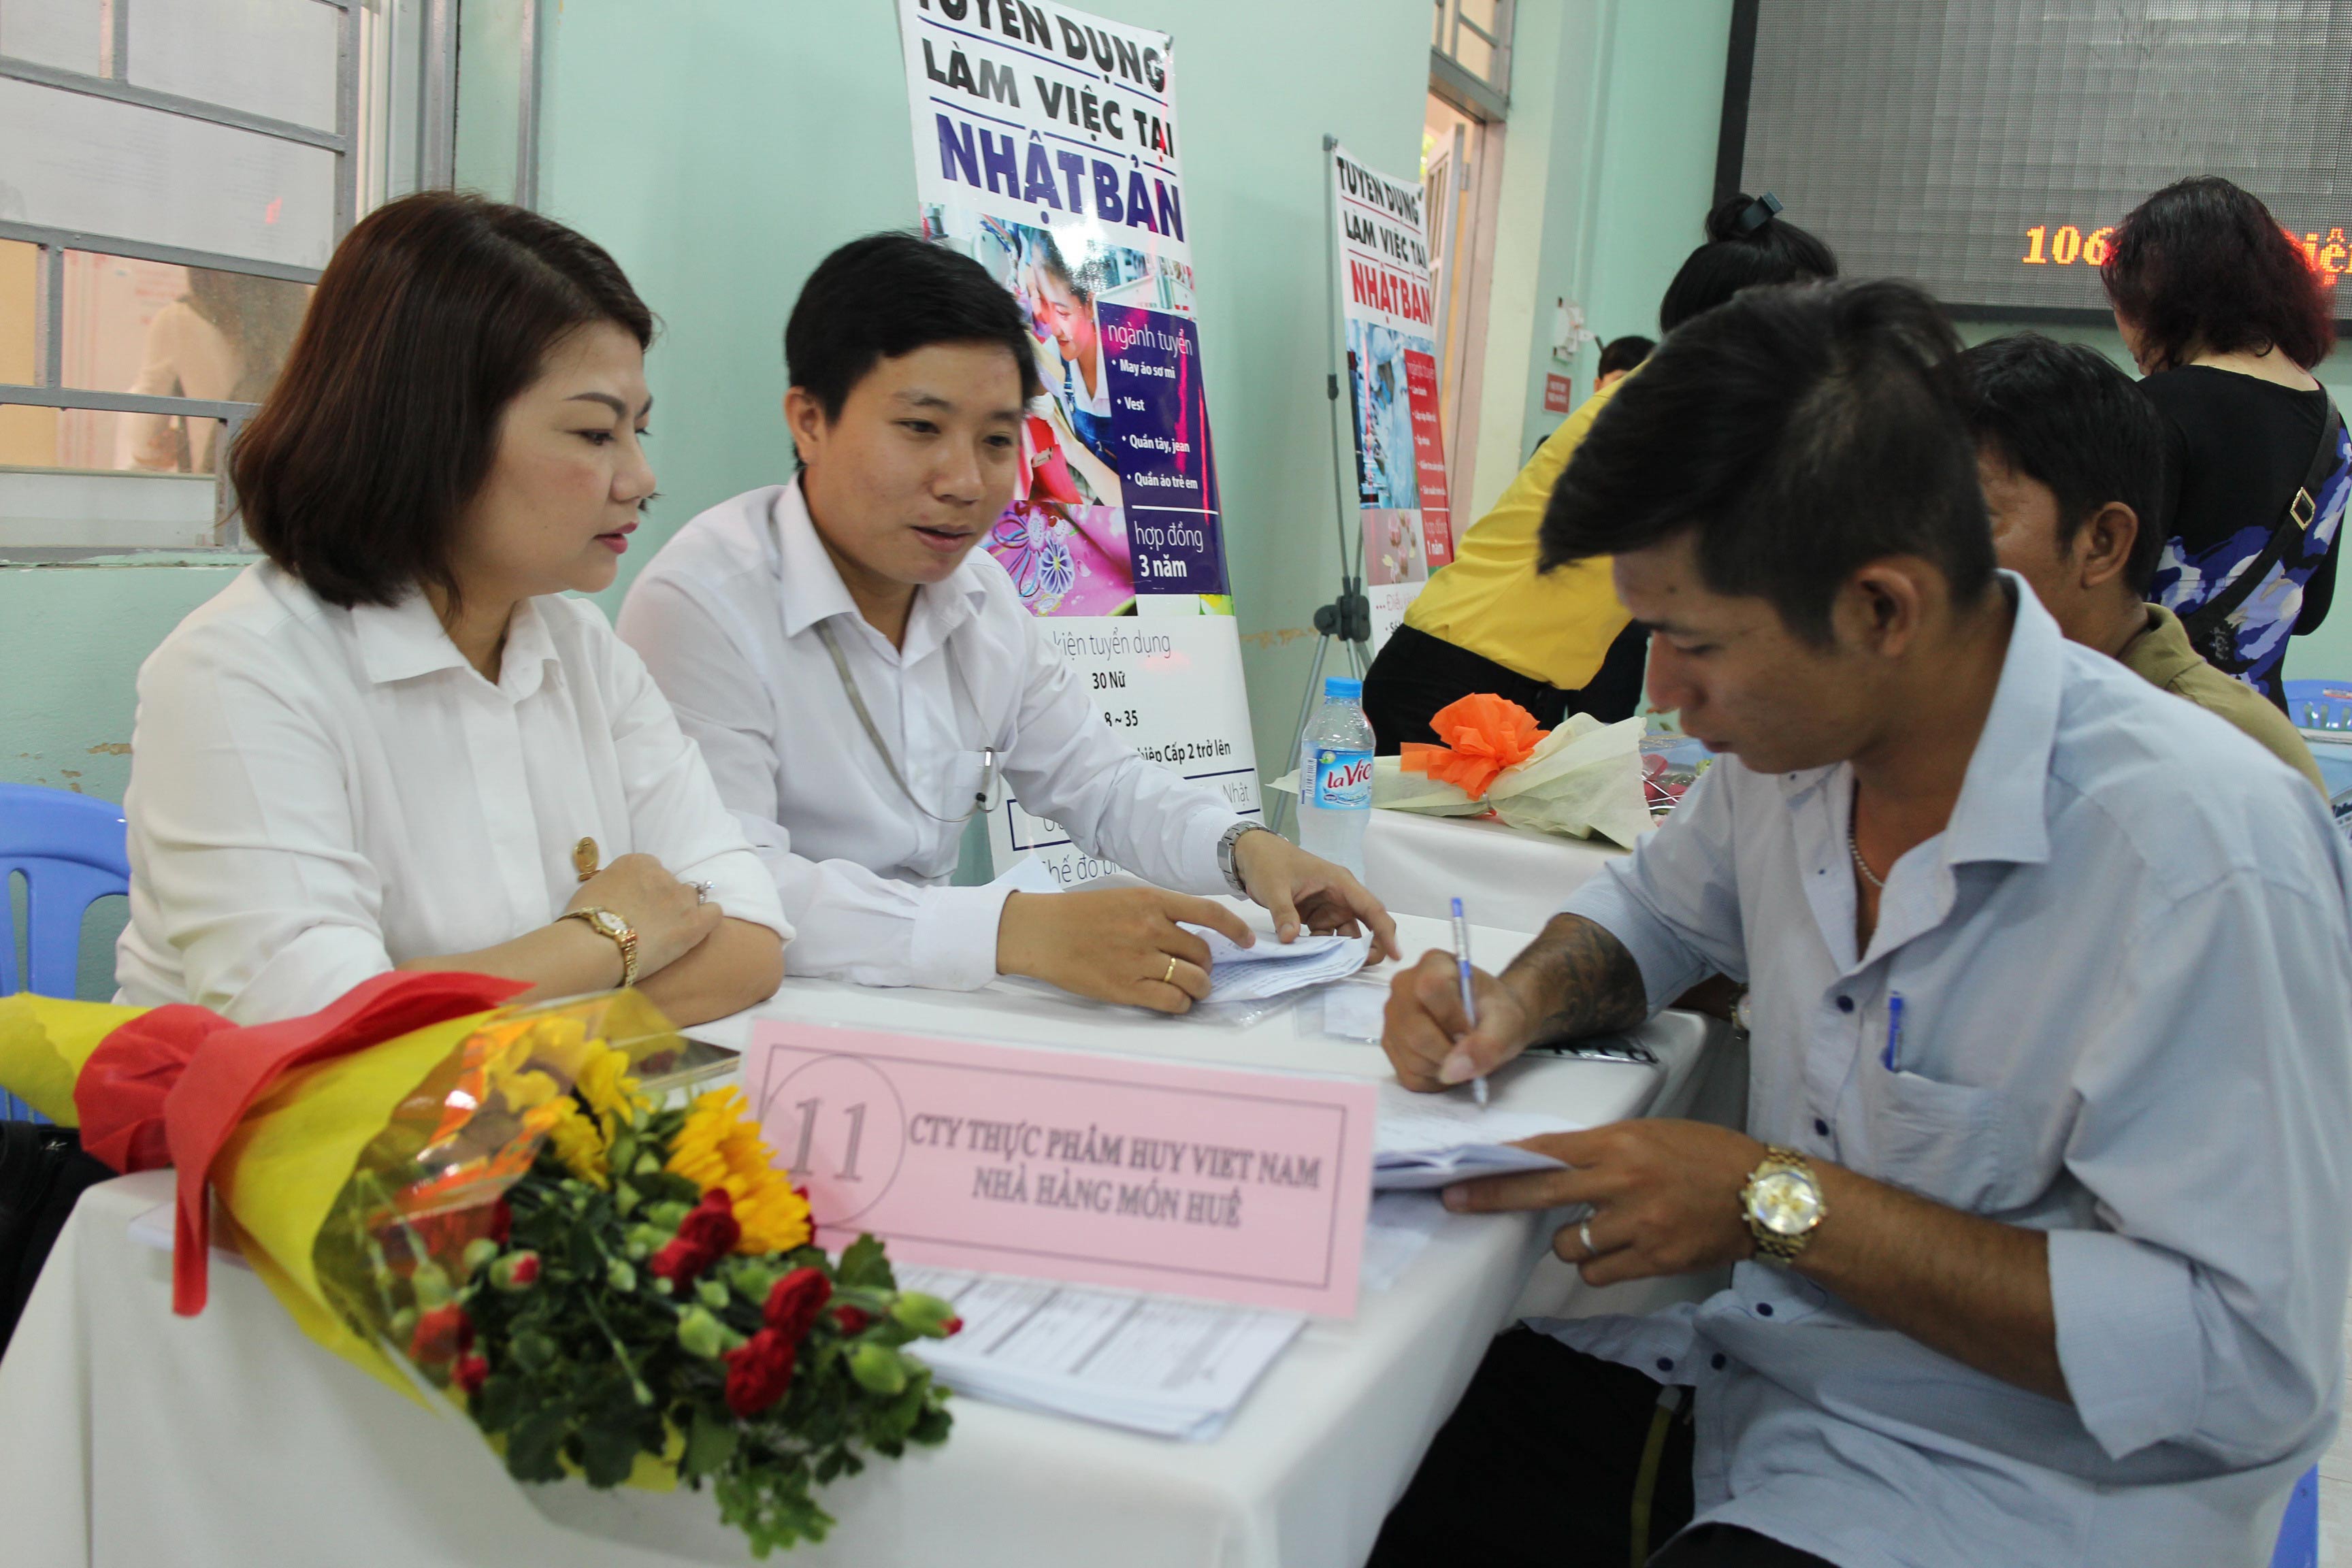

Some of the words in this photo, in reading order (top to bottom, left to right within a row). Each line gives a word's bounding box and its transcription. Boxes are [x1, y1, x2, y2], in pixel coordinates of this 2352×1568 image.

[1055, 14, 1165, 93] DỤNG
[922, 38, 1020, 108] LÀM
[1034, 75, 1124, 142] VIỆC
[1132, 108, 1175, 163] TẠI
[1343, 209, 1377, 248] LÀM
[1108, 322, 1156, 350] ngành
[1157, 328, 1192, 358] tuyển
[1120, 359, 1139, 376] May
[1141, 361, 1152, 375] áo
[1153, 366, 1164, 376] sơ
[1164, 366, 1176, 379] mi
[1124, 397, 1145, 411] Vest
[1130, 434, 1154, 449] Quần
[1172, 439, 1190, 454] jean
[1134, 471, 1159, 487] Quần
[1160, 473, 1171, 487] áo
[1173, 474, 1185, 489] trẻ
[1186, 479, 1198, 489] em
[1134, 521, 1164, 551] hợp
[1167, 521, 1204, 553] đồng
[1139, 555, 1150, 577] 3
[1153, 554, 1188, 577] năm
[1089, 627, 1130, 662] tuyển
[1134, 630, 1171, 659] dụng
[1092, 672, 1107, 689] 30
[1109, 671, 1126, 688] Nữ
[1124, 710, 1139, 727] 35
[1164, 741, 1186, 765] Cấp
[1187, 743, 1194, 759] 2
[1196, 740, 1213, 758] trở
[1214, 739, 1231, 756] lên
[1222, 782, 1250, 806] Nhật
[788, 1097, 866, 1183] 11
[909, 1112, 963, 1149] CTY
[1128, 1136, 1188, 1174] HUY
[1256, 1151, 1322, 1191] NAM
[972, 1164, 1029, 1204] NHÀ
[1115, 1177, 1182, 1222] MÓN
